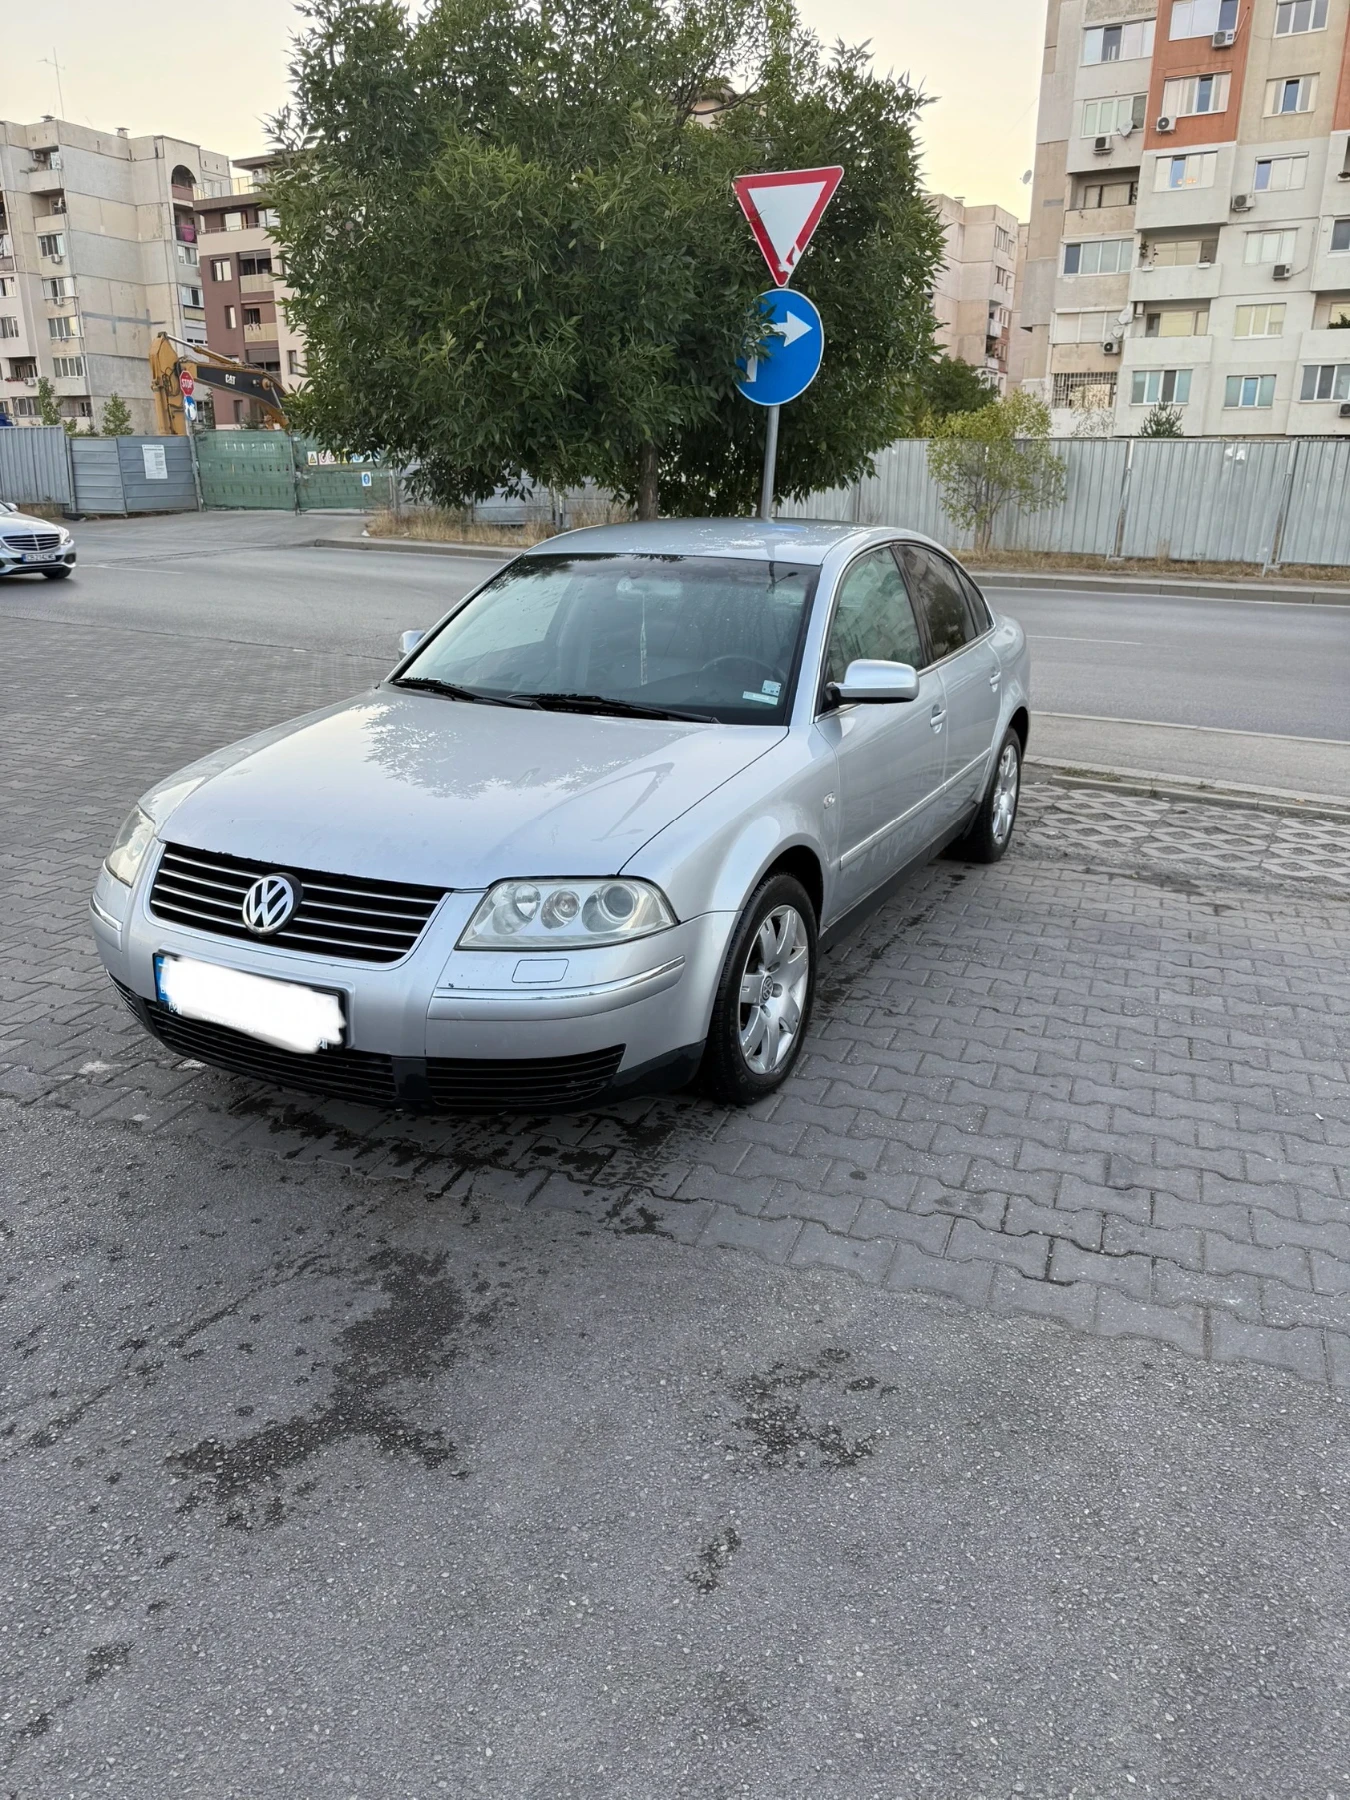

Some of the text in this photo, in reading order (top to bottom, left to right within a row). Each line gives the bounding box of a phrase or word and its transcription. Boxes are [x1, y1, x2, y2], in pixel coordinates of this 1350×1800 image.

[181, 379, 193, 389] STOP
[225, 373, 236, 385] CAT
[245, 876, 292, 932] VW
